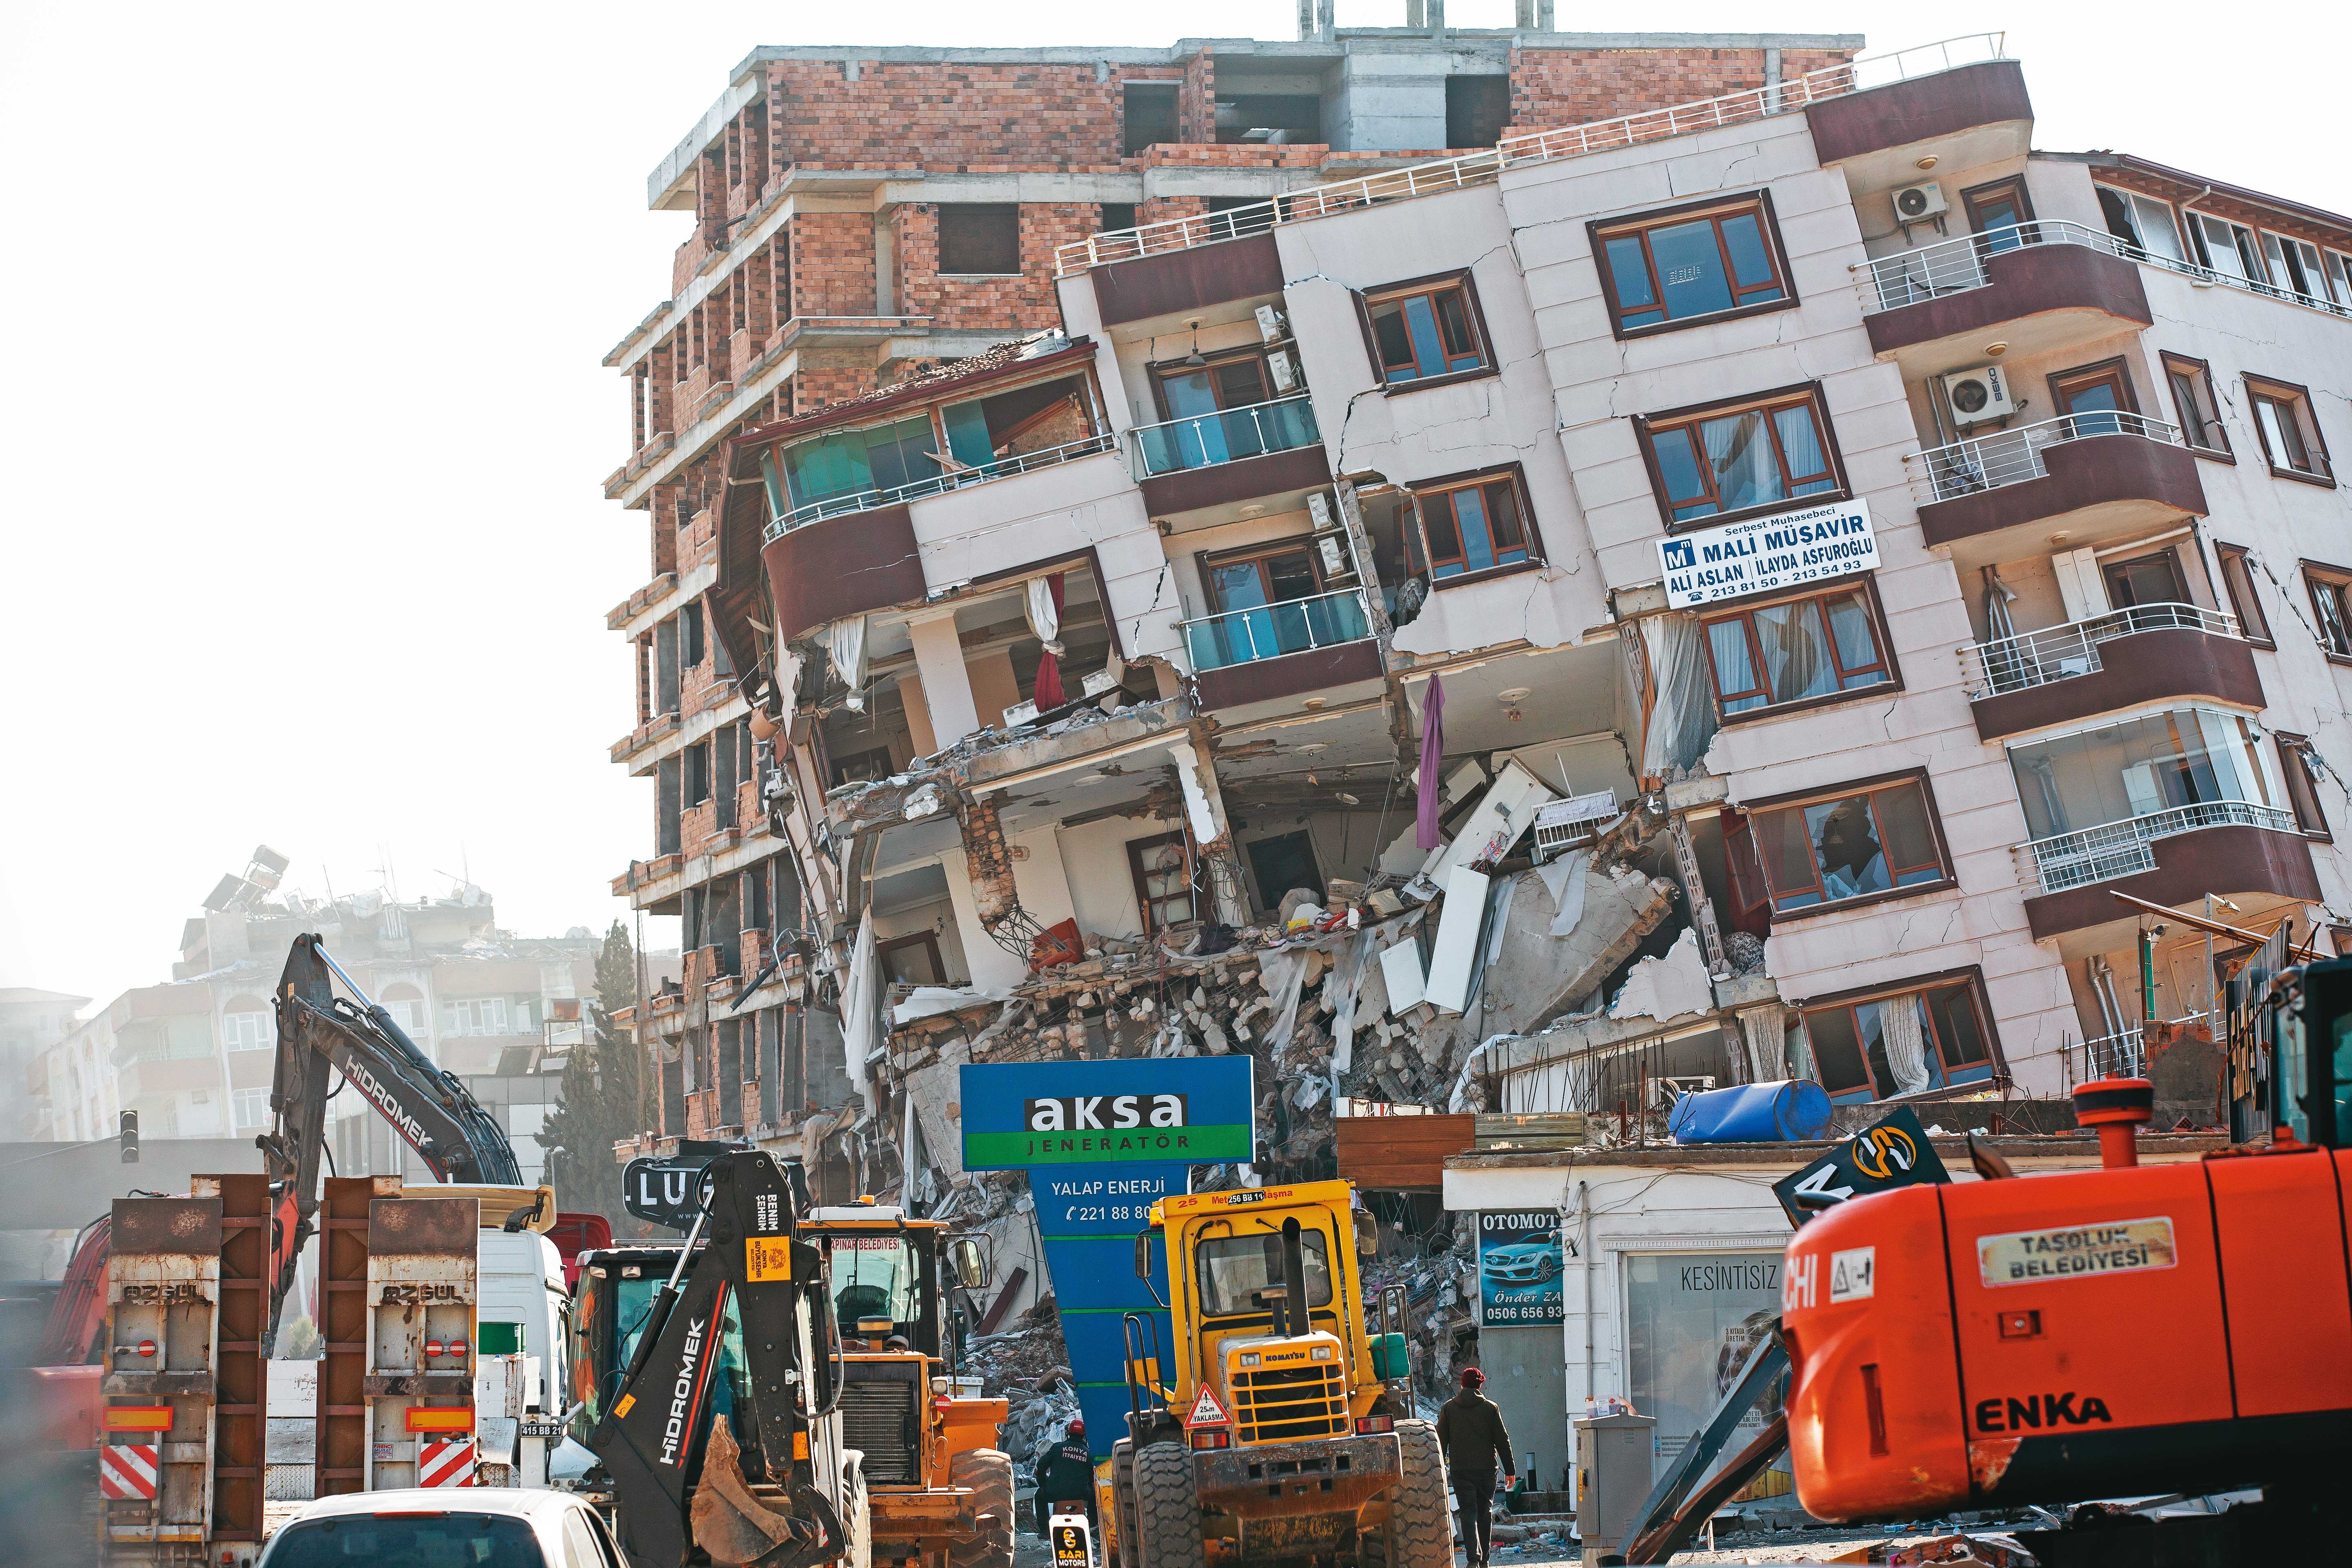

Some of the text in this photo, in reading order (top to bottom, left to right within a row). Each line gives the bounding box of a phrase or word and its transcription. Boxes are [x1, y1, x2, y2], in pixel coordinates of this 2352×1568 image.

[1988, 368, 2002, 401] BEKO
[1725, 506, 1835, 536] Serbest Muhasebeci
[1703, 513, 1865, 563] MALİ MÜŞAVİR
[1671, 537, 1873, 593] ALİ ASLAN İLAYDA ASFUROĞLU
[1711, 586, 1736, 597] 213
[1741, 581, 1755, 592] 81
[1761, 577, 1778, 588] 50
[1793, 569, 1817, 581] 213
[1822, 565, 1839, 575] 54
[1844, 560, 1861, 570] 93
[1031, 1094, 1183, 1131] aksa
[1028, 1133, 1189, 1156] JENERATÖR
[1051, 1176, 1165, 1196] YALAP ENERJİ
[1177, 1197, 1198, 1208] 25
[1228, 1195, 1241, 1203] 256
[1255, 1193, 1263, 1201] 14
[1080, 1207, 1105, 1221] 221
[1111, 1207, 1129, 1220] 88
[815, 1238, 856, 1250] KAPINAR
[2009, 1243, 2148, 1278] BELEDİYESİ
[1682, 1260, 1777, 1291] KESİNTİSİZ
[1494, 1290, 1564, 1303] Önder ZA
[1487, 1306, 1562, 1319] 0506 656 93
[1266, 1351, 1305, 1362] KOMATSU
[1194, 1413, 1224, 1423] YAKLAŞMA
[1976, 1392, 2112, 1432] ENKA
[522, 1426, 561, 1435] 415 BB 21
[1062, 1446, 1087, 1457] KONYA
[1058, 1550, 1085, 1559] SARI
